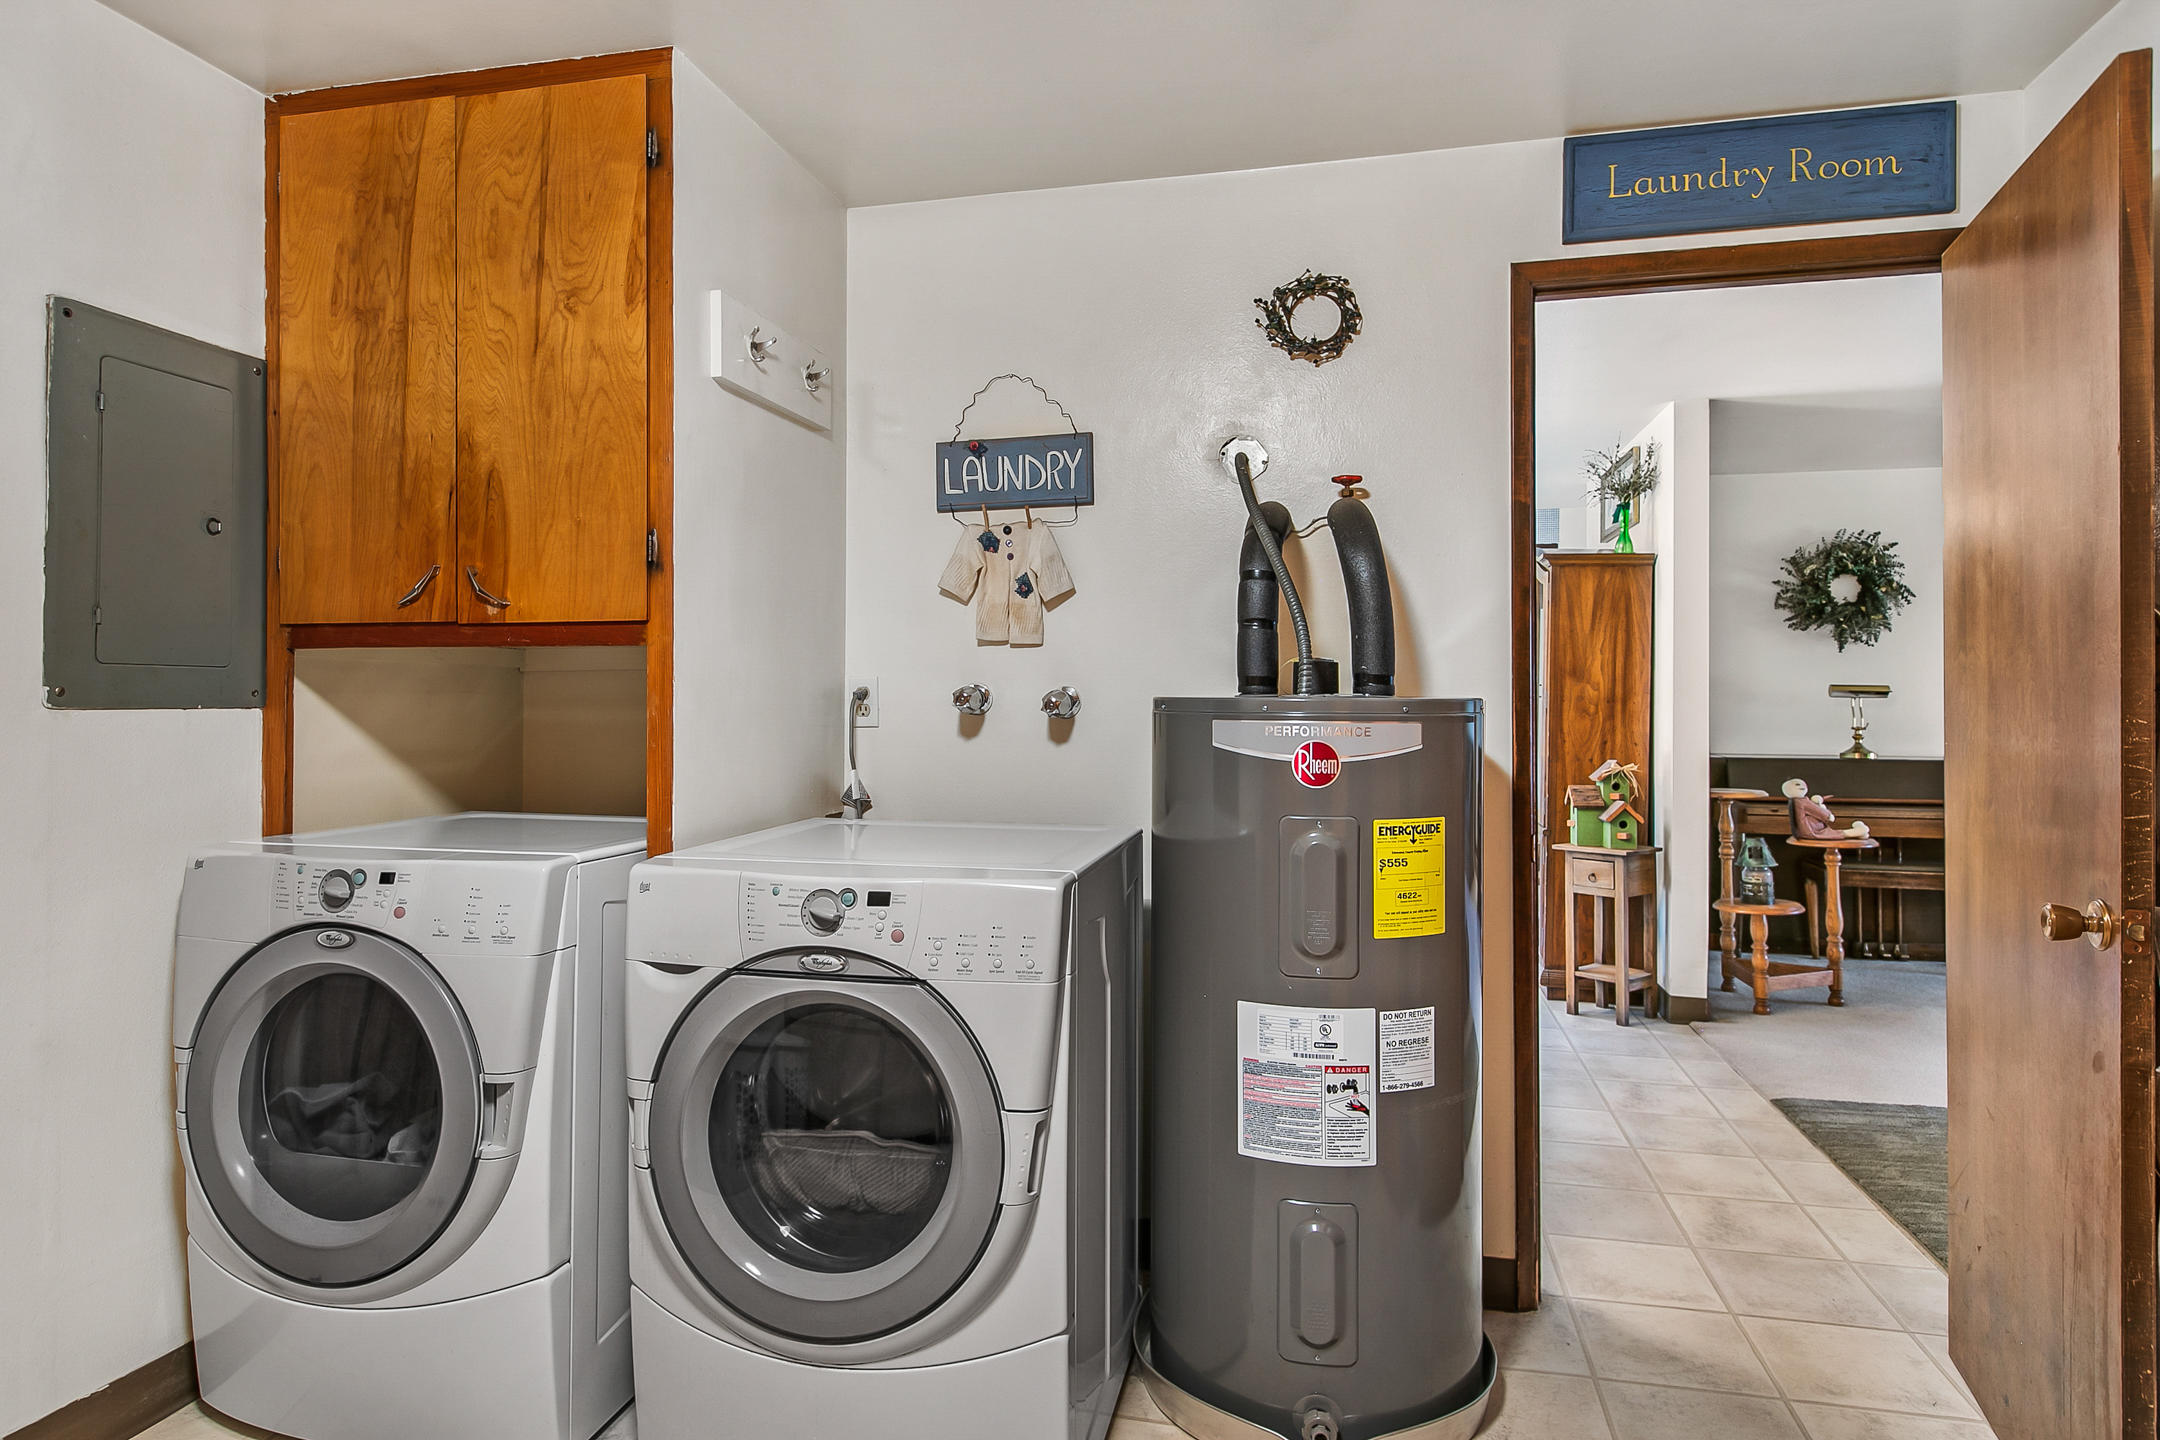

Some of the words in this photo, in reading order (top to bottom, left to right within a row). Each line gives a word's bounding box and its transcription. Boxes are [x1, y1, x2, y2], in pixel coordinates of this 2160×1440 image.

[1608, 157, 1775, 199] Laundry
[1789, 147, 1903, 184] Room
[944, 448, 1083, 495] LAUNDRY
[1264, 725, 1372, 738] PERFORMANCE
[1298, 742, 1338, 780] Rheem
[1378, 823, 1441, 837] ENERGYGUIDE
[1379, 858, 1409, 868] $555
[1383, 1013, 1393, 1021] DO
[1394, 1011, 1408, 1020] NOT
[1408, 1009, 1432, 1018] RETURN
[1386, 1040, 1397, 1048] NO
[1398, 1036, 1430, 1047] REGRESE
